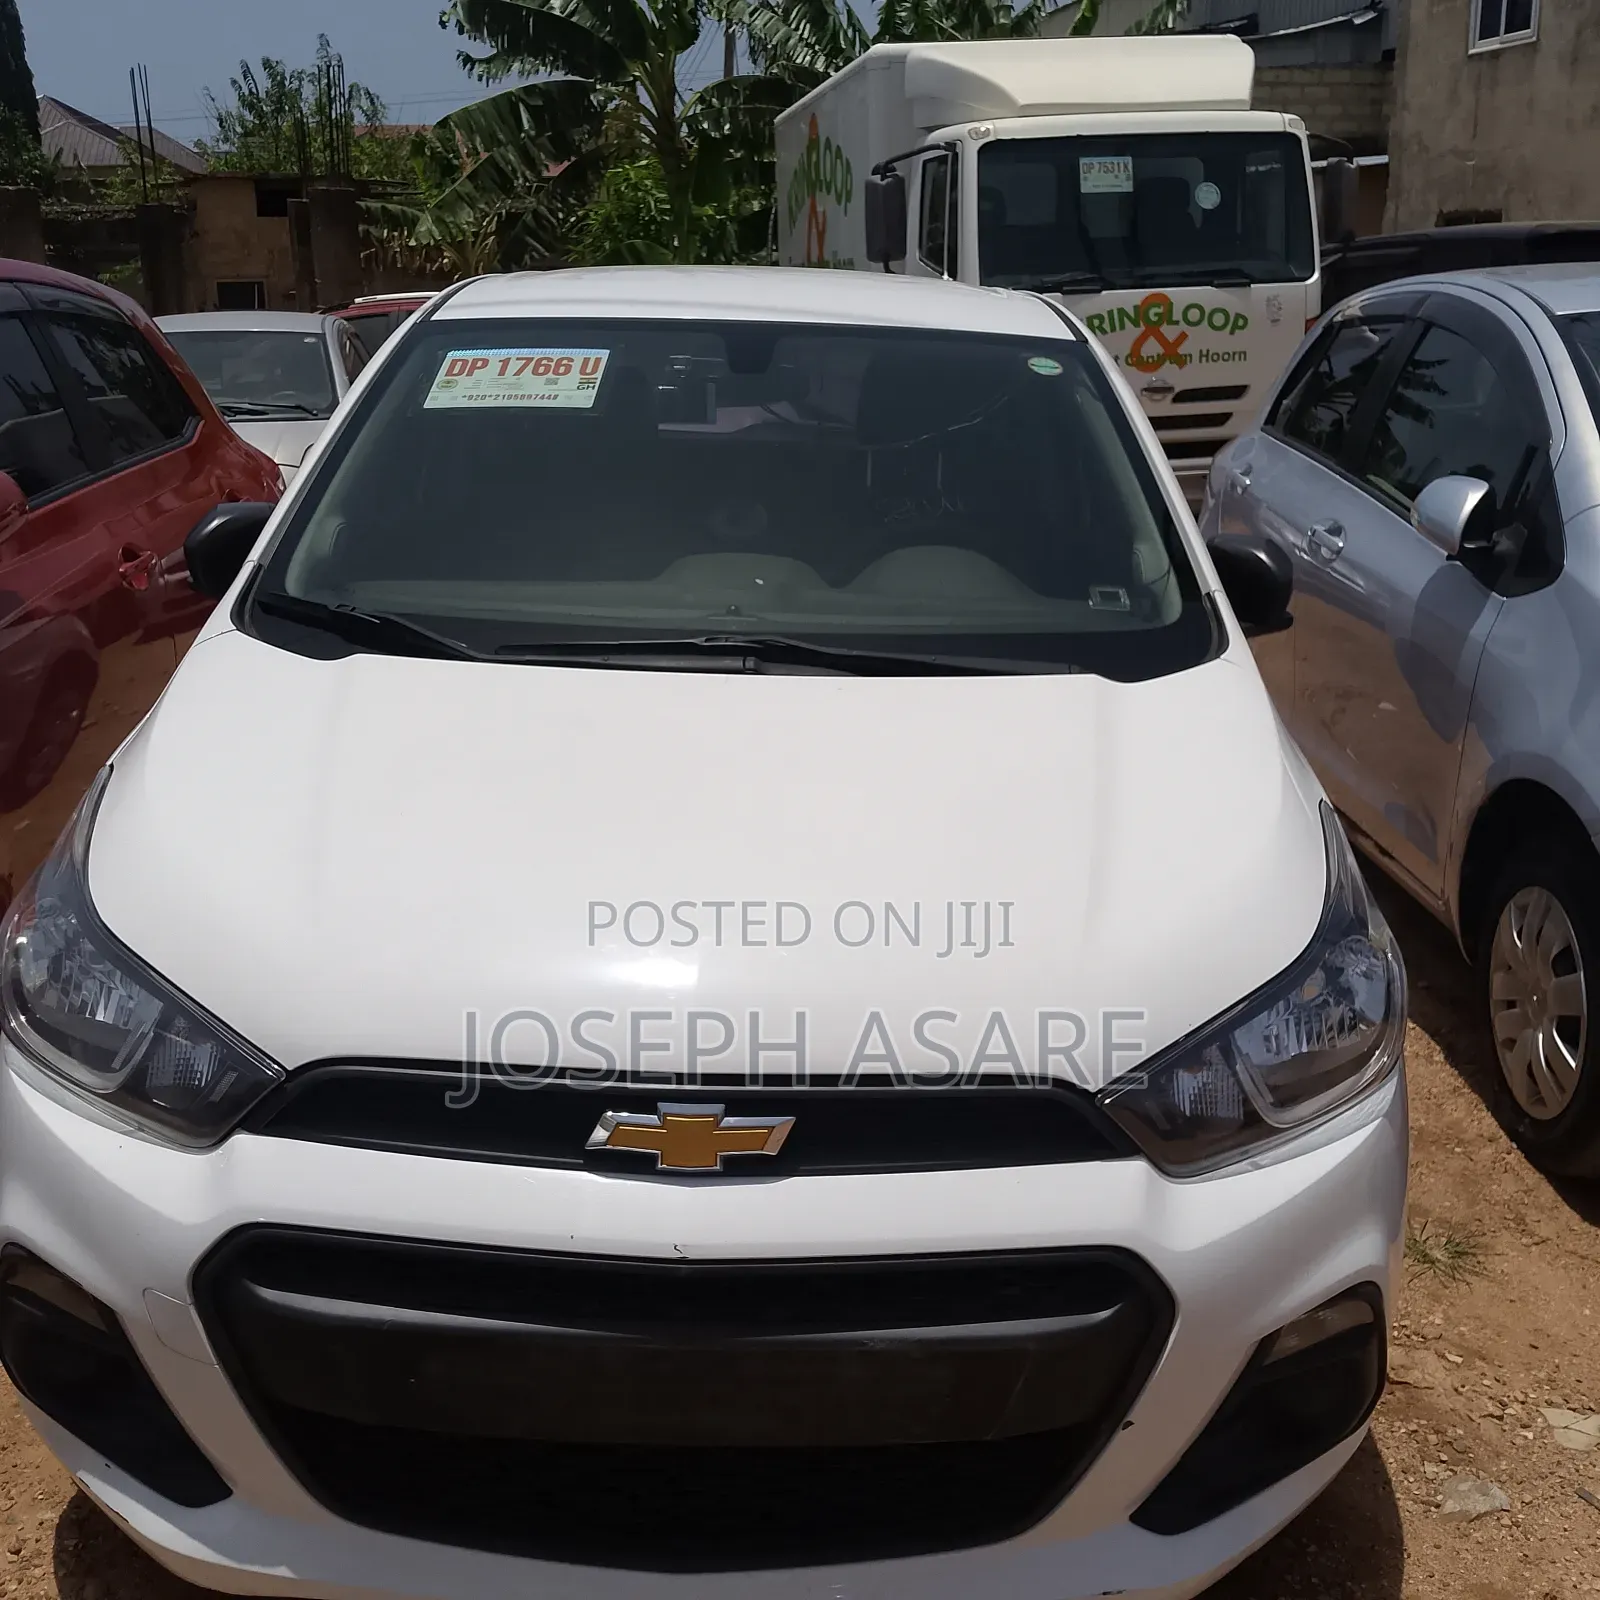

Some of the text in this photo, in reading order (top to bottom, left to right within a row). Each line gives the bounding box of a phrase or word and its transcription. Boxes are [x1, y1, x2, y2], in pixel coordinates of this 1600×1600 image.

[1085, 300, 1249, 336] RINGLOOP
[445, 356, 603, 377] DP 1766 U
[1198, 349, 1247, 364] Hoorn
